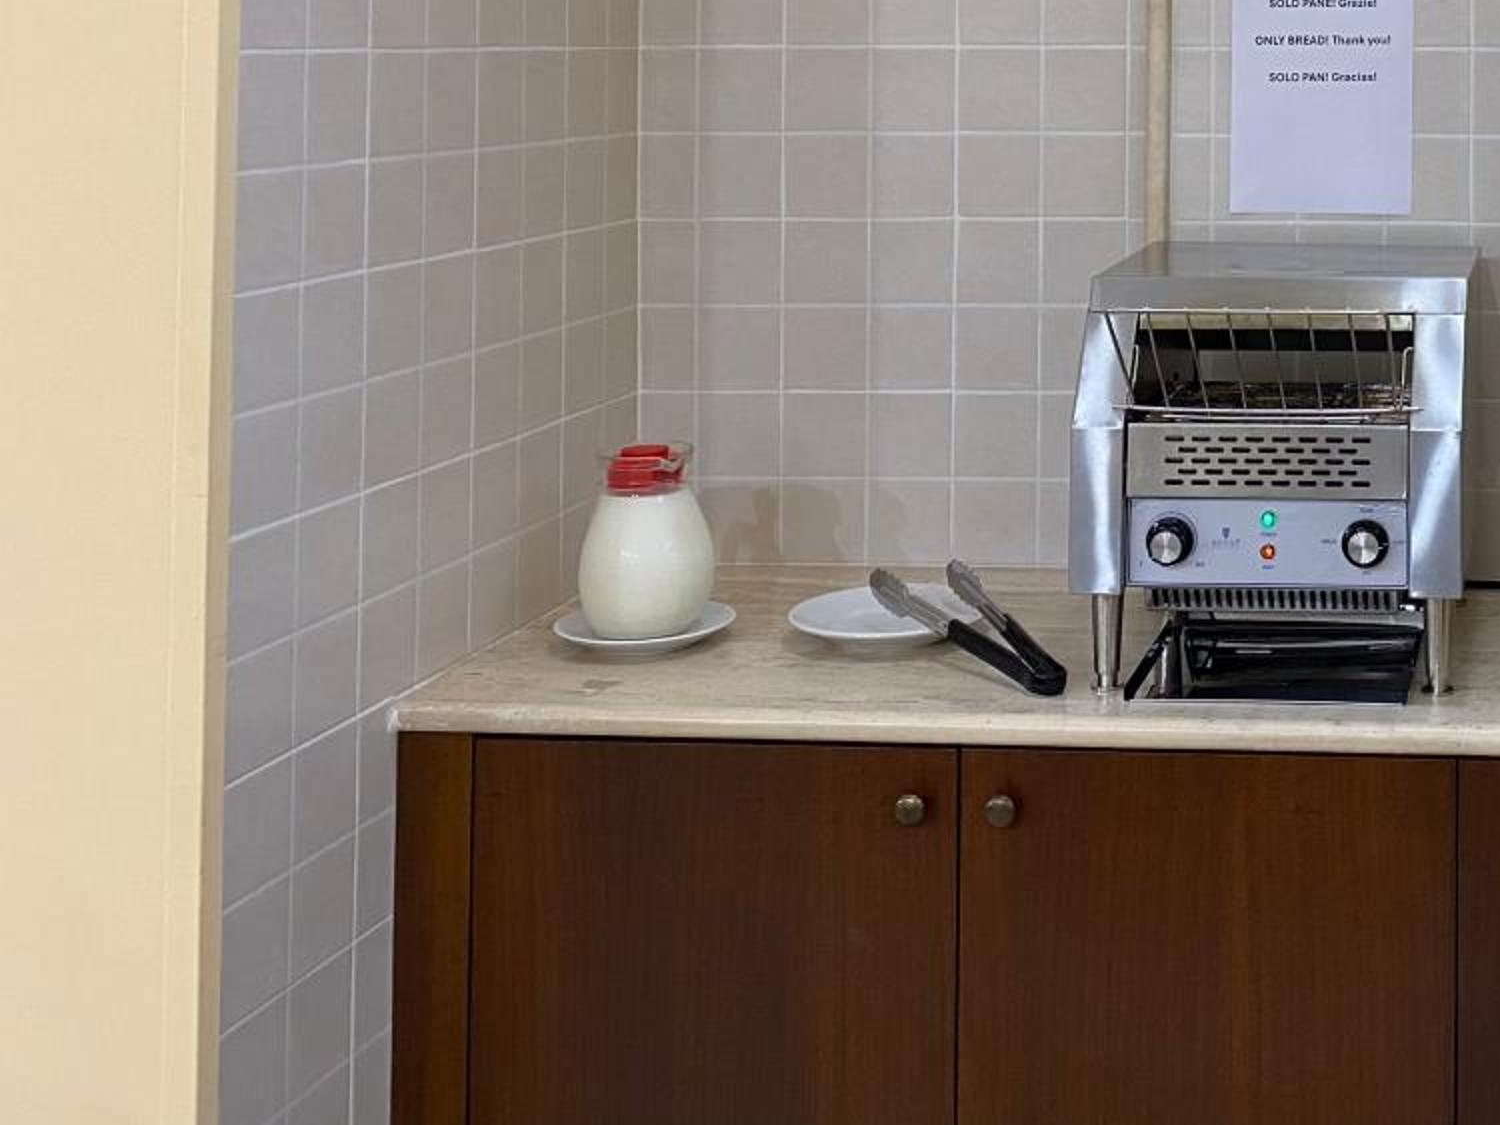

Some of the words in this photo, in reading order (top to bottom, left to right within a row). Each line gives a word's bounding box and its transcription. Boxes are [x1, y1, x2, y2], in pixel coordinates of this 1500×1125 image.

[1254, 35, 1285, 46] ONLY
[1287, 35, 1329, 46] BREAD!
[1332, 35, 1365, 46] Thank
[1367, 35, 1392, 47] you!
[1268, 72, 1300, 82] SOLO
[1301, 72, 1329, 82] PAN!
[1331, 72, 1377, 82] Gracias!
